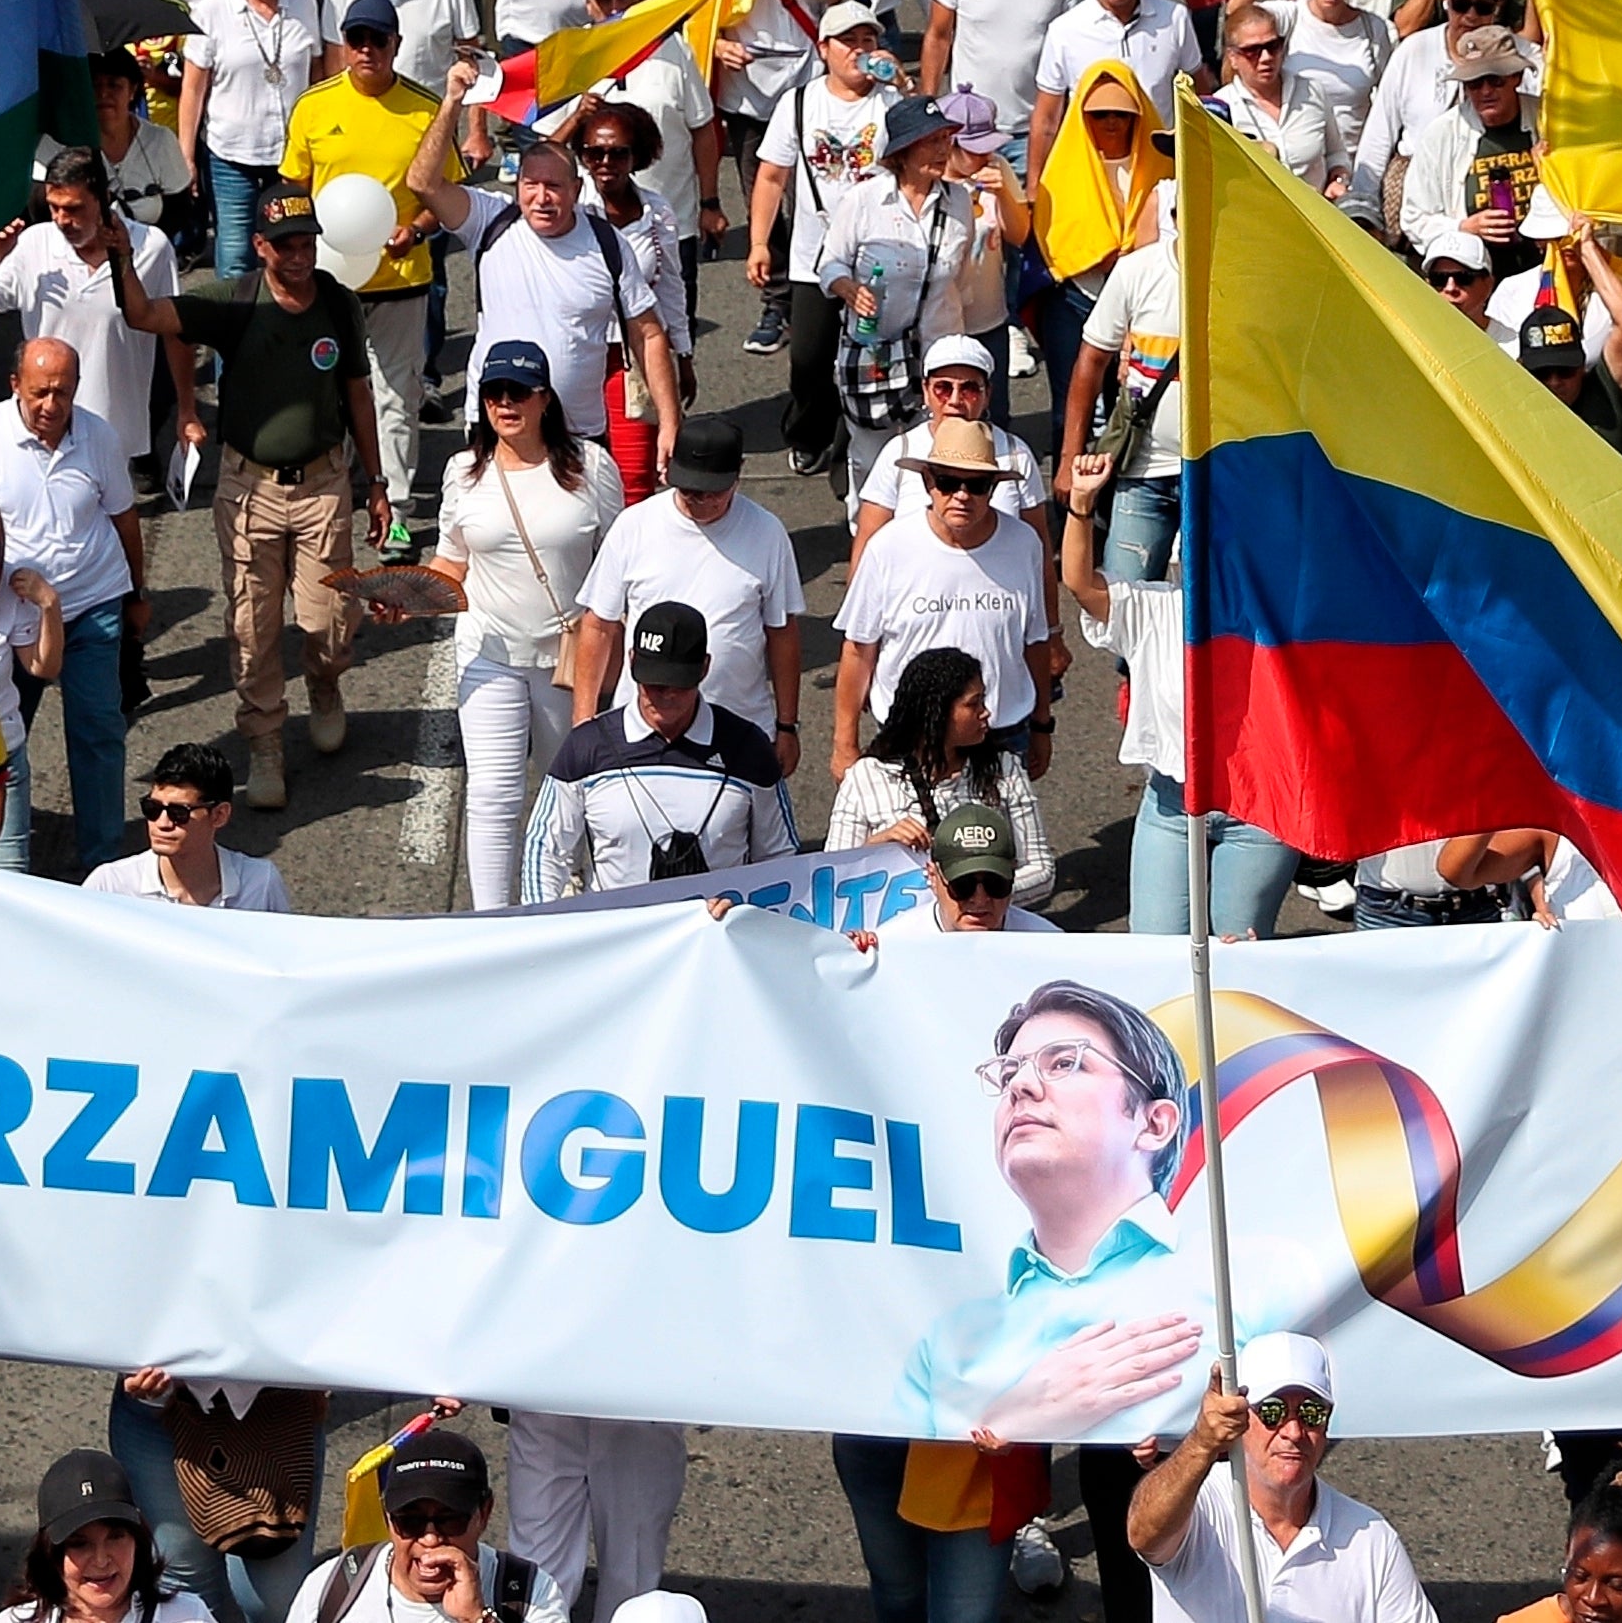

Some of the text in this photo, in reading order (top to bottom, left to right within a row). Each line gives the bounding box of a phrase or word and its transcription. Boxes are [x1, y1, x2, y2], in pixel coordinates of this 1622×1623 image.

[912, 591, 1017, 614] Calvin Klein
[953, 825, 997, 843] AERO
